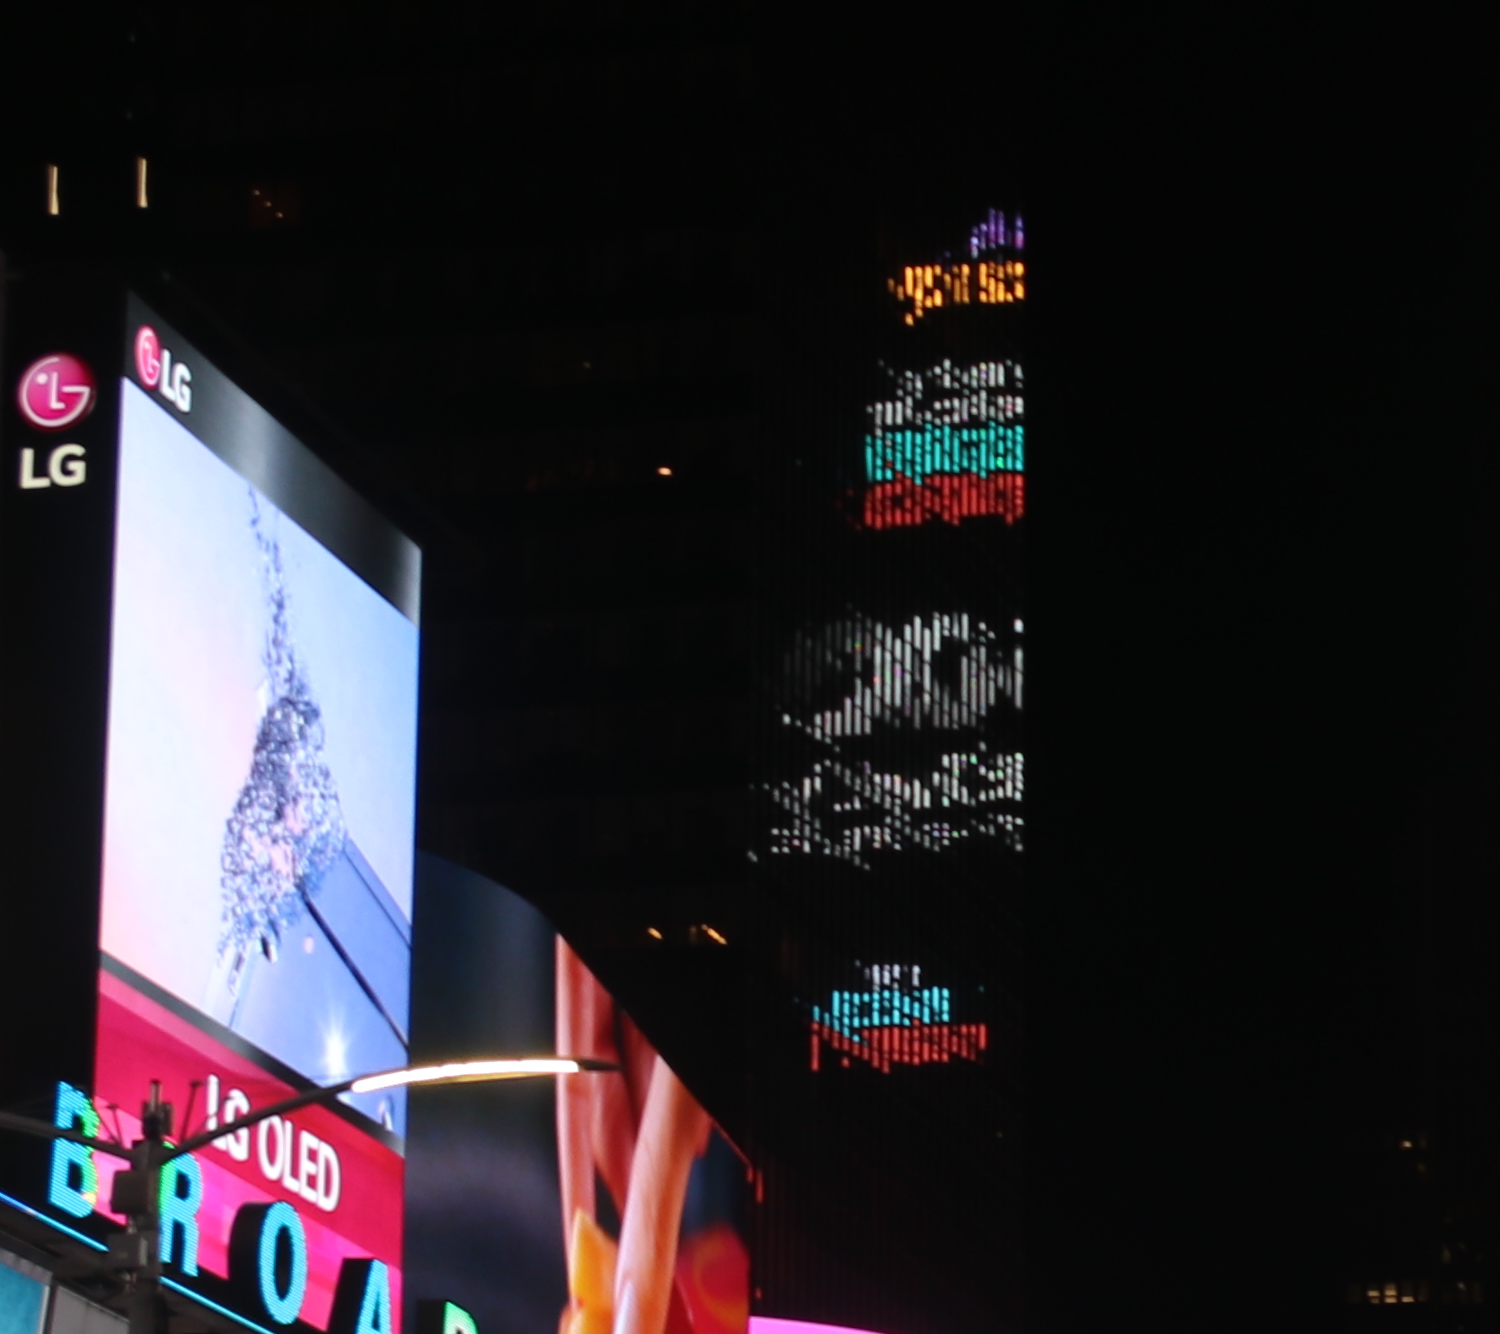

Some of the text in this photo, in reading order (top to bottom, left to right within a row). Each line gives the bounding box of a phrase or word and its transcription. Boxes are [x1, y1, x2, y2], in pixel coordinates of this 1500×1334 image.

[159, 347, 193, 413] LG
[19, 443, 88, 489] LG
[204, 1074, 342, 1213] LG OLED
